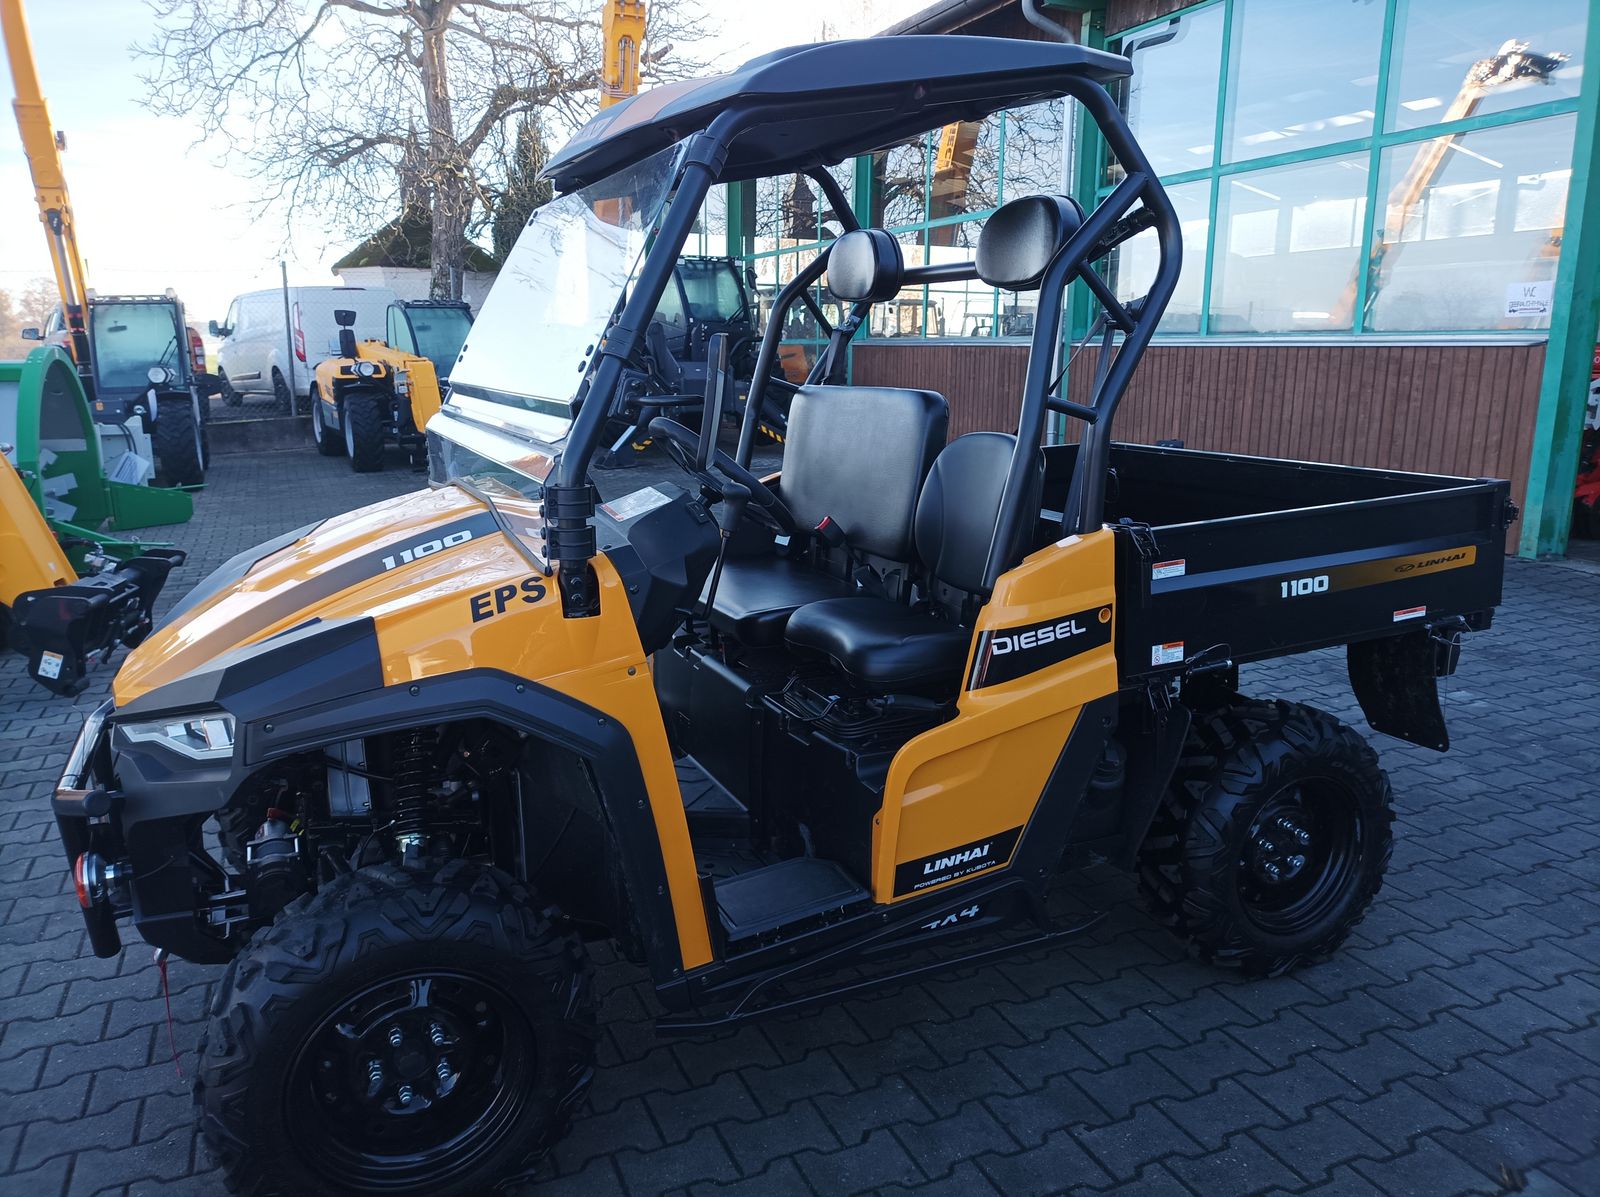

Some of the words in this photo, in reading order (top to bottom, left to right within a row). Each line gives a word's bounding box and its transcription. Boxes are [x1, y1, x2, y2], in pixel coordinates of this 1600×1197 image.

[1523, 286, 1537, 297] WC
[382, 530, 472, 570] 1100
[1416, 552, 1466, 569] LINHAI
[470, 576, 546, 623] EPS
[1280, 575, 1329, 598] 1100
[991, 619, 1086, 656] DIESEL
[923, 844, 990, 875] LINHAI
[913, 874, 952, 890] POWERED
[953, 869, 964, 877] BY
[966, 860, 996, 874] KUBOTA
